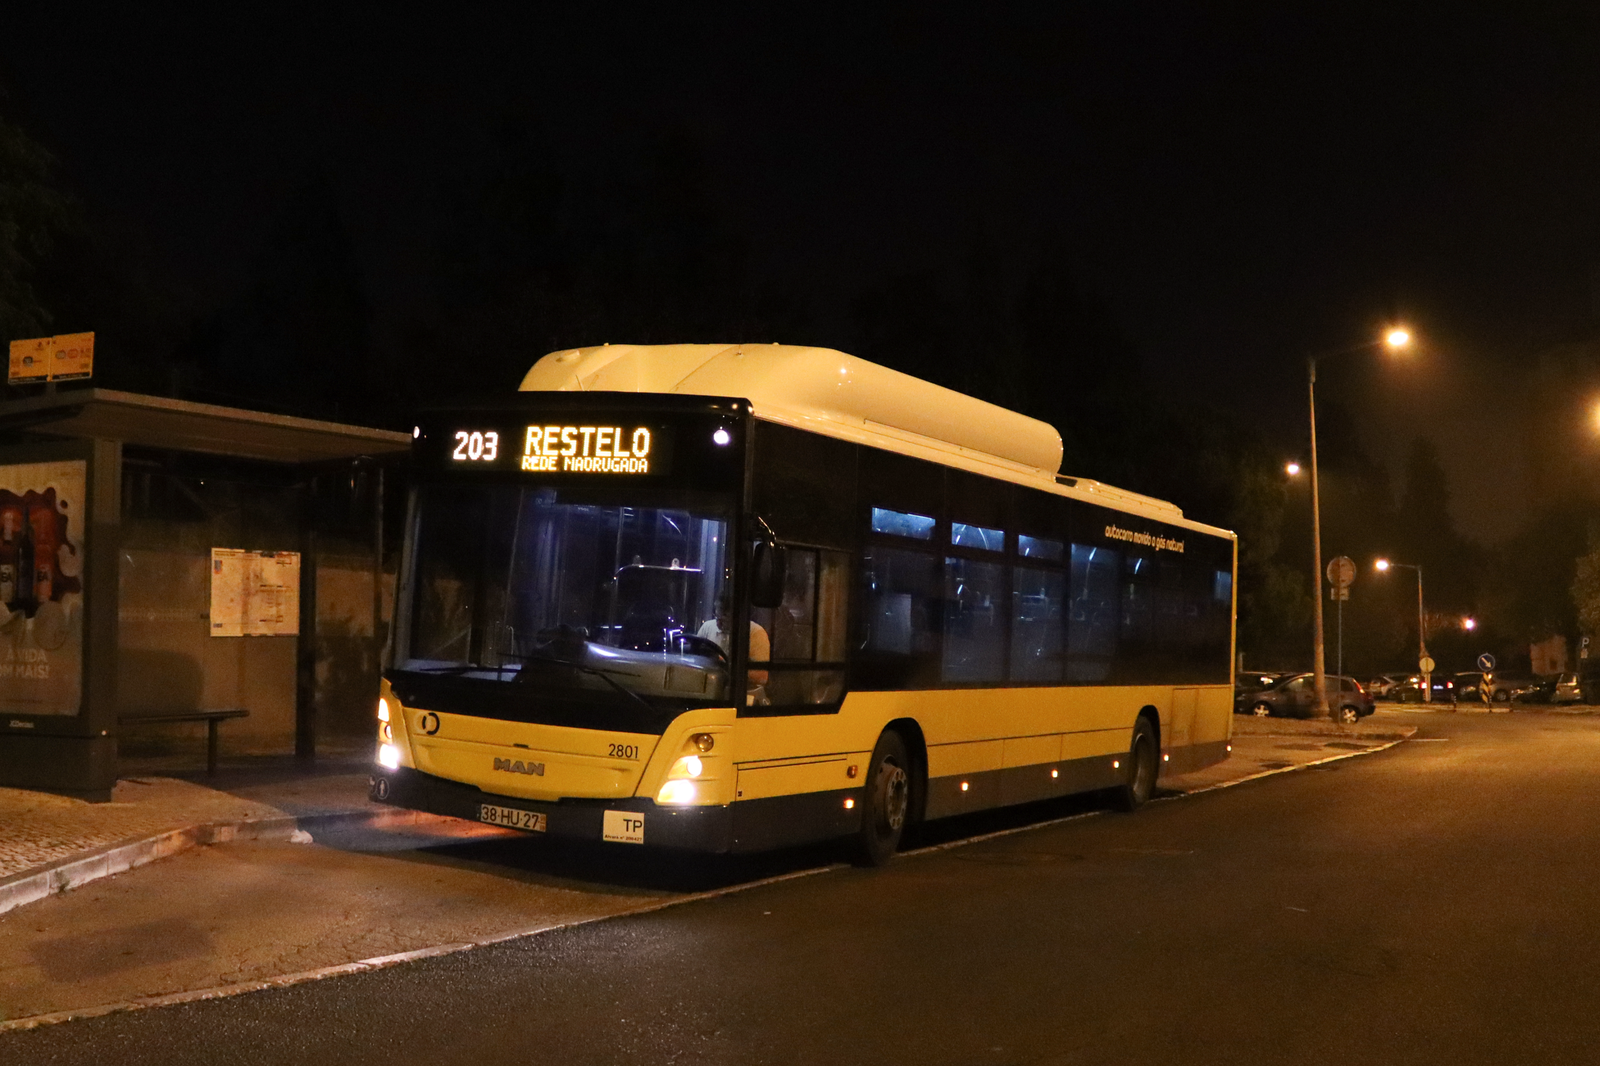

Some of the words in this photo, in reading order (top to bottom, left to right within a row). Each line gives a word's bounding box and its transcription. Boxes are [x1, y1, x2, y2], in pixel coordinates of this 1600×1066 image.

[453, 431, 499, 460] 203
[525, 426, 650, 457] RESTELO
[521, 455, 558, 471] REDE
[564, 457, 649, 473] MADRUGADA
[608, 743, 639, 759] 2801
[493, 757, 545, 776] MAN
[623, 818, 642, 832] TP
